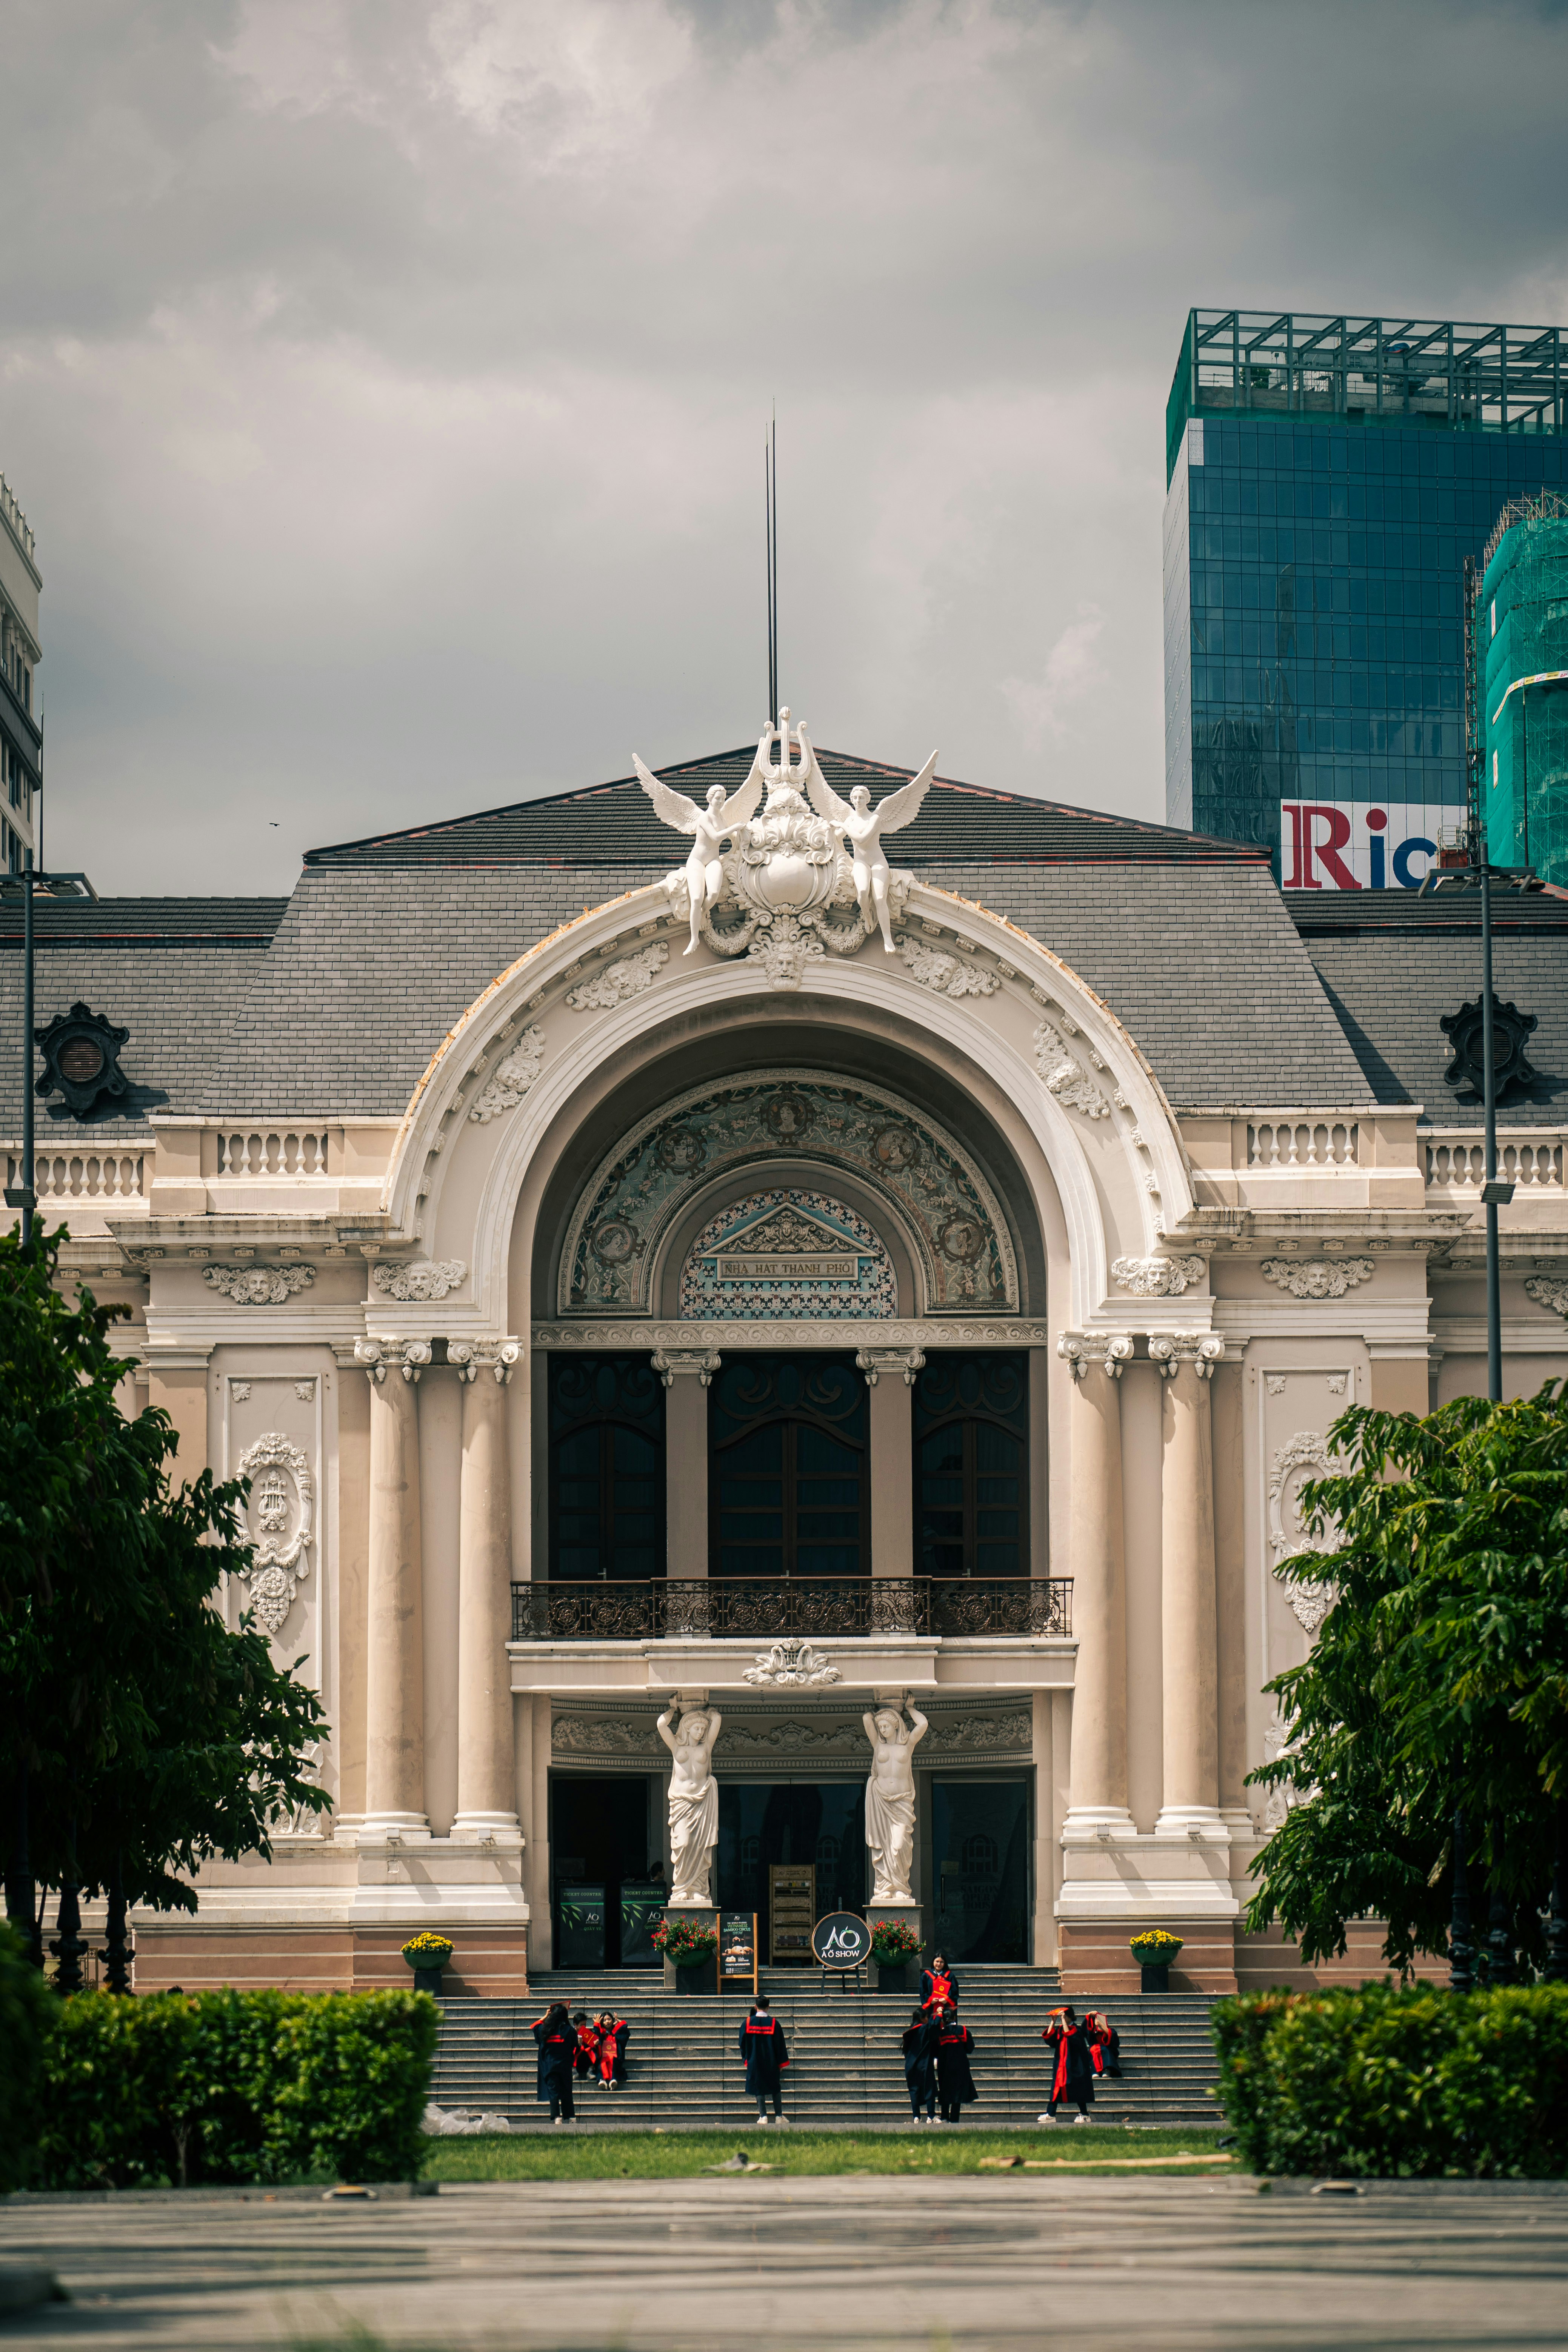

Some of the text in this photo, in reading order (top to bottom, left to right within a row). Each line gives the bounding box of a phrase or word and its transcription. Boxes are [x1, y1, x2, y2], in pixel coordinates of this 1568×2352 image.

[725, 1261, 850, 1274] NHÀ HÁT THÀNH PHỐ
[821, 1950, 827, 1958] À
[828, 1949, 834, 1958] Ố
